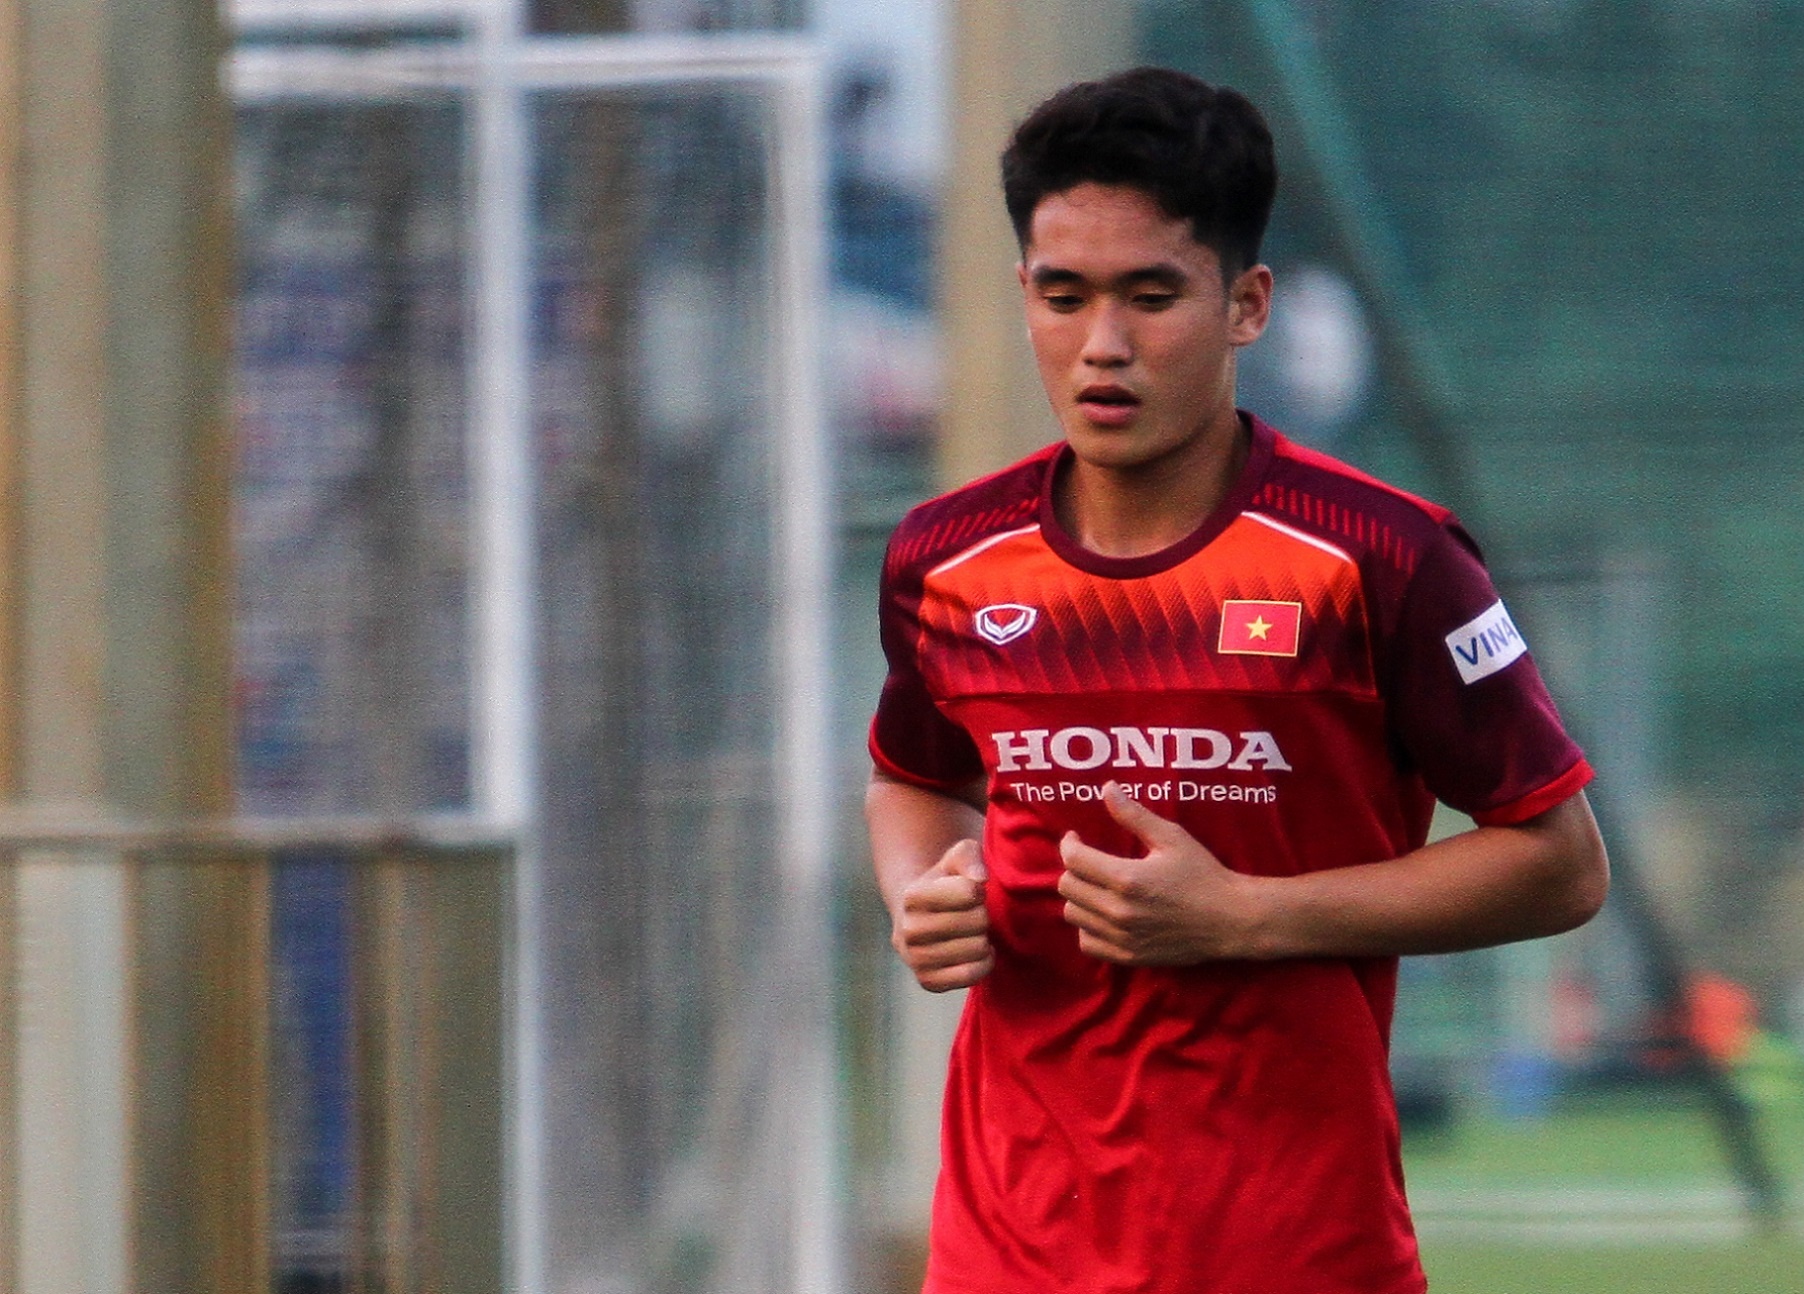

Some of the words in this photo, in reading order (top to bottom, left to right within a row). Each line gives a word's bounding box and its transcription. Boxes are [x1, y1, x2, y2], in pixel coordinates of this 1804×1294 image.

[992, 726, 1293, 772] HONDA
[1011, 782, 1055, 802] The
[1147, 780, 1172, 801] of
[1179, 781, 1277, 804] Dreams
